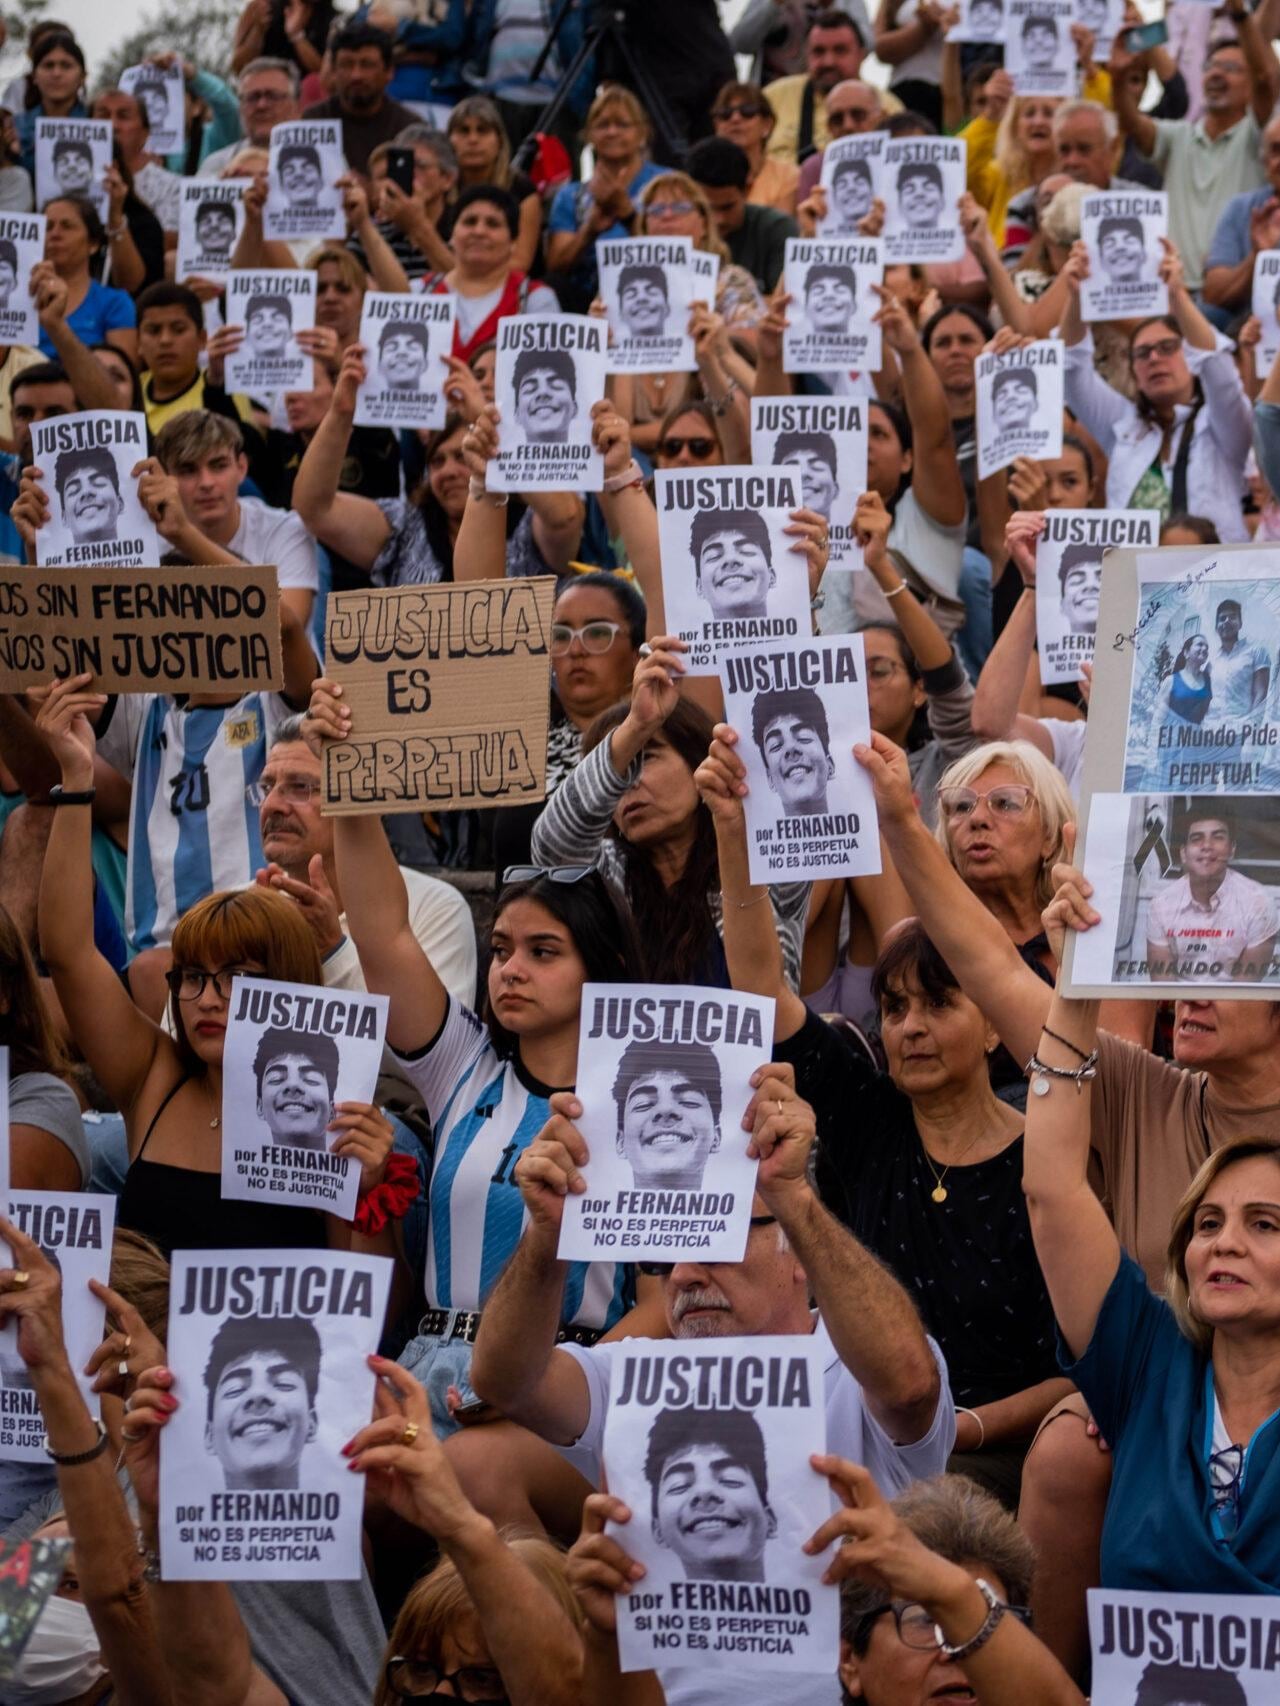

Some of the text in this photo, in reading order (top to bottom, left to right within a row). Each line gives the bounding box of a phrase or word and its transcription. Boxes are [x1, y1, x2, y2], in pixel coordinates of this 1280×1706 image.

[40, 124, 108, 142] JUSTICIA
[185, 186, 244, 203] JUSTICI
[1085, 198, 1163, 217] JUSTICIA
[602, 244, 687, 266] JUSTICIA
[789, 244, 878, 265] JUSTICIA
[232, 277, 312, 296] JUSTICIA
[368, 301, 451, 322] JUSTICIA
[501, 324, 601, 352] JUSTICIA
[978, 347, 1059, 376] JUSTICIA
[756, 406, 862, 431] JUSTICIA
[37, 418, 140, 456] JUSTICIA
[517, 445, 591, 461] FERNANDO
[664, 477, 796, 511] JUSTICIA
[1042, 518, 1152, 544] JUSTICIA
[45, 556, 62, 567] por
[66, 539, 144, 564] FERNANDO
[37, 584, 78, 617] SIN
[92, 584, 266, 619] FERNANDO
[330, 586, 547, 663] JUSTICIA
[679, 618, 798, 642] por FERNANDO
[53, 635, 103, 680] SIN
[112, 633, 272, 680] JUSTICIA
[726, 648, 858, 694] JUSTICIA
[387, 669, 431, 714] ES
[1158, 723, 1277, 748] El Mundo Pide
[327, 730, 537, 802] PERPETUA
[1169, 762, 1261, 785] PERPETUA!
[756, 813, 861, 842] por FERNANDO
[1178, 929, 1221, 937] JUSTICIA
[1187, 944, 1207, 952] POR
[1116, 960, 1223, 977] FERNANDO
[235, 988, 377, 1040] JUSTICIA
[588, 997, 763, 1048] JUSTICIA
[234, 1145, 348, 1177] por FERNANDO
[581, 1191, 735, 1216] por FERNANDO
[583, 1218, 726, 1232] SI NO ES PERPETUA
[594, 1234, 710, 1247] NO ES JUSTICIA
[180, 1266, 372, 1318] JUSTICIA
[616, 1356, 810, 1408] JUSTICIA
[176, 1492, 340, 1524] por FERNANDO
[629, 1582, 811, 1616] por FERNANDO
